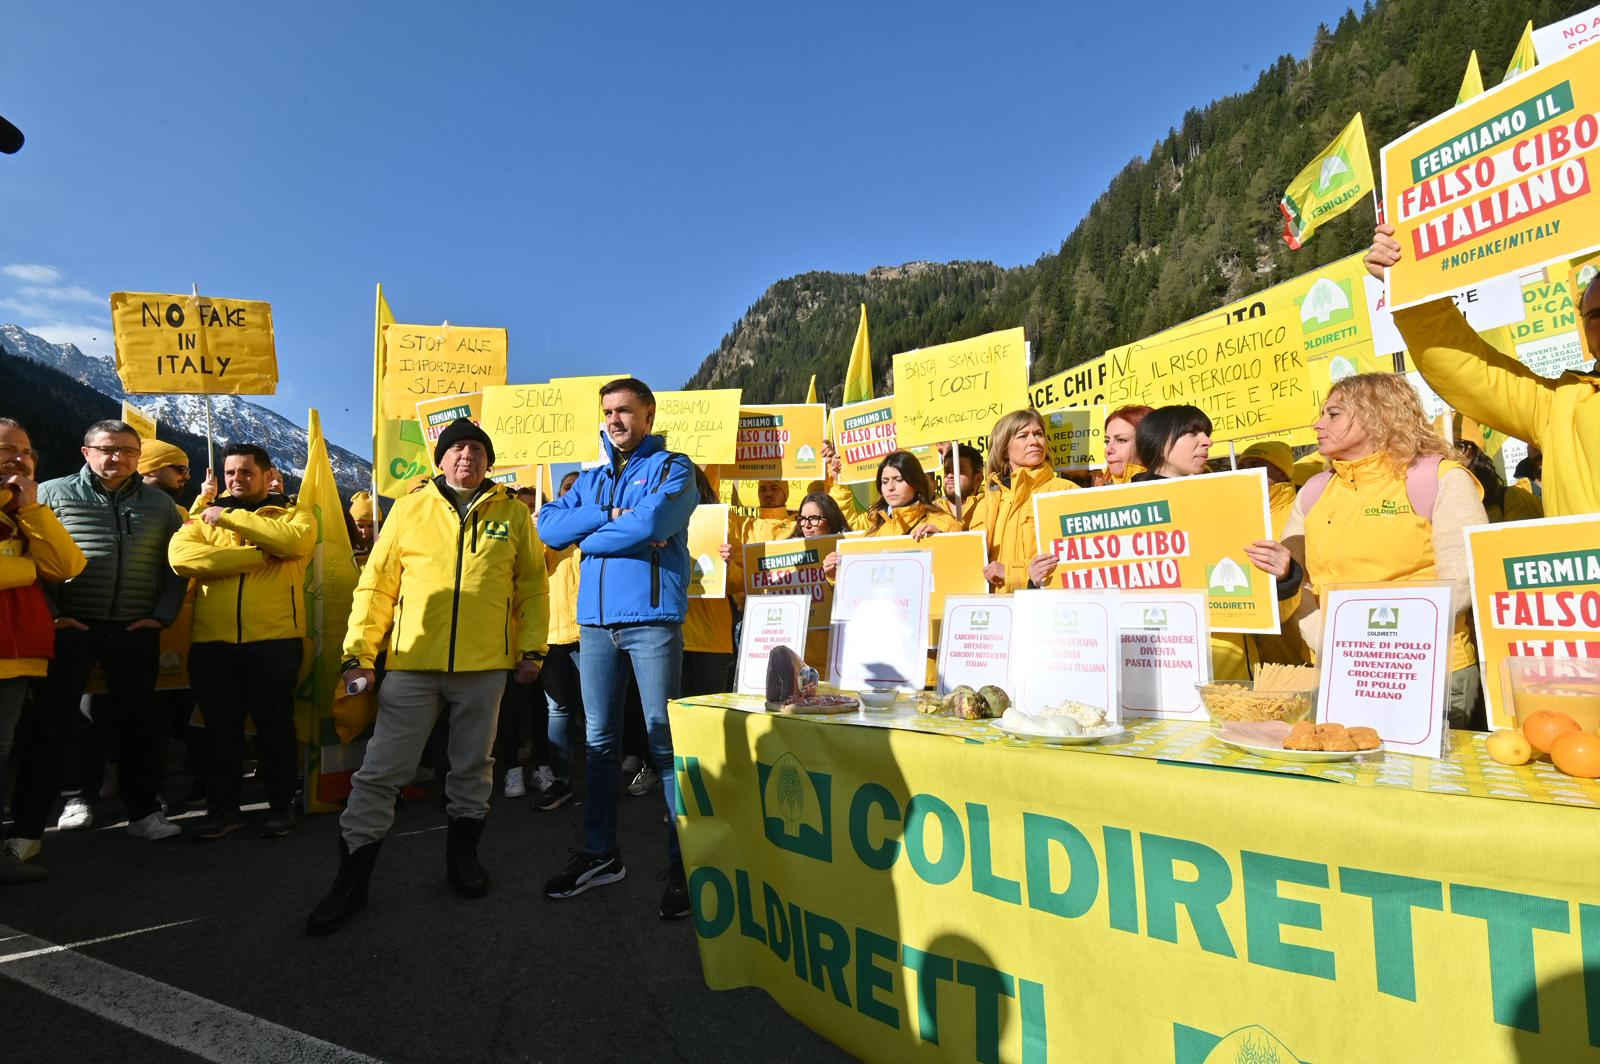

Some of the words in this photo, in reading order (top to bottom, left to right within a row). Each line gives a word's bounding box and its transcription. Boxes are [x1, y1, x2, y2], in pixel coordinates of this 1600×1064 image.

[1563, 24, 1586, 39] NO
[1419, 110, 1527, 178] FERMIAMO
[1537, 95, 1560, 121] IL
[1402, 156, 1496, 218] FALSO
[1511, 114, 1600, 172] CIBO
[1417, 159, 1585, 254] ITALIANO
[142, 302, 185, 328] NO
[199, 304, 246, 328] FAKE
[1552, 311, 1575, 329] IN
[178, 333, 196, 350] IN
[400, 334, 447, 351] STOP
[456, 338, 491, 352] ALLE
[1152, 361, 1167, 379] IL
[1170, 348, 1208, 374] RISO
[1216, 326, 1286, 362] ASIATICO
[157, 355, 231, 377] ITALY
[400, 359, 491, 375] IMPORTAZIONI
[904, 359, 936, 380] BASTA
[948, 344, 1011, 369] SCARICARE
[1064, 368, 1092, 398] CHI
[1162, 380, 1183, 401] UN
[1189, 359, 1261, 393] PERICOLO
[1273, 351, 1303, 373] PER
[408, 377, 477, 394] SLEALI
[928, 380, 935, 402] I
[940, 371, 989, 397] COSTI
[1248, 386, 1260, 403] E
[1270, 378, 1303, 400] PER
[512, 388, 563, 408] SENZA
[428, 411, 457, 425] FERMIAMO
[459, 407, 467, 418] IL
[657, 400, 709, 415] ABBIAMO
[920, 402, 1003, 431] AGRICOLTORI
[495, 413, 575, 435] AGRICOLTORI
[695, 420, 723, 431] DELLA
[846, 413, 880, 430] FERMIAMO
[881, 410, 889, 420] IL
[765, 430, 789, 442] CIBO
[841, 428, 870, 444] FALSO
[1054, 428, 1100, 440] REDDITO
[536, 440, 574, 458] CIBO
[847, 439, 897, 463] ITALIANO
[1066, 509, 1141, 534] FERMIAMO
[1147, 505, 1163, 522] IL
[1053, 534, 1120, 561] FALSO
[1133, 529, 1185, 556] CIBO
[761, 554, 804, 570] FERMIAMO
[806, 552, 815, 563] IL
[753, 570, 792, 587] FALSO
[798, 567, 826, 583] CIBO
[1066, 559, 1178, 589] ITALIANO
[1208, 601, 1256, 610] COLDIRETTI
[1495, 591, 1600, 628] FALSO
[1150, 634, 1195, 644] CANADESE
[1335, 640, 1376, 649] FETTINE
[1379, 641, 1391, 649] DI
[1394, 642, 1432, 650] POLLO
[1140, 647, 1176, 656] DIVENTA
[1342, 650, 1426, 660] SUDAMERICANO
[1125, 658, 1152, 668] PASTA
[1154, 659, 1193, 669] ITALIANA
[1353, 660, 1413, 670] DIVENTANO
[1347, 669, 1418, 680] CROCCHETTE
[1371, 680, 1406, 690] POLLO
[1354, 690, 1402, 700] ITALIANO
